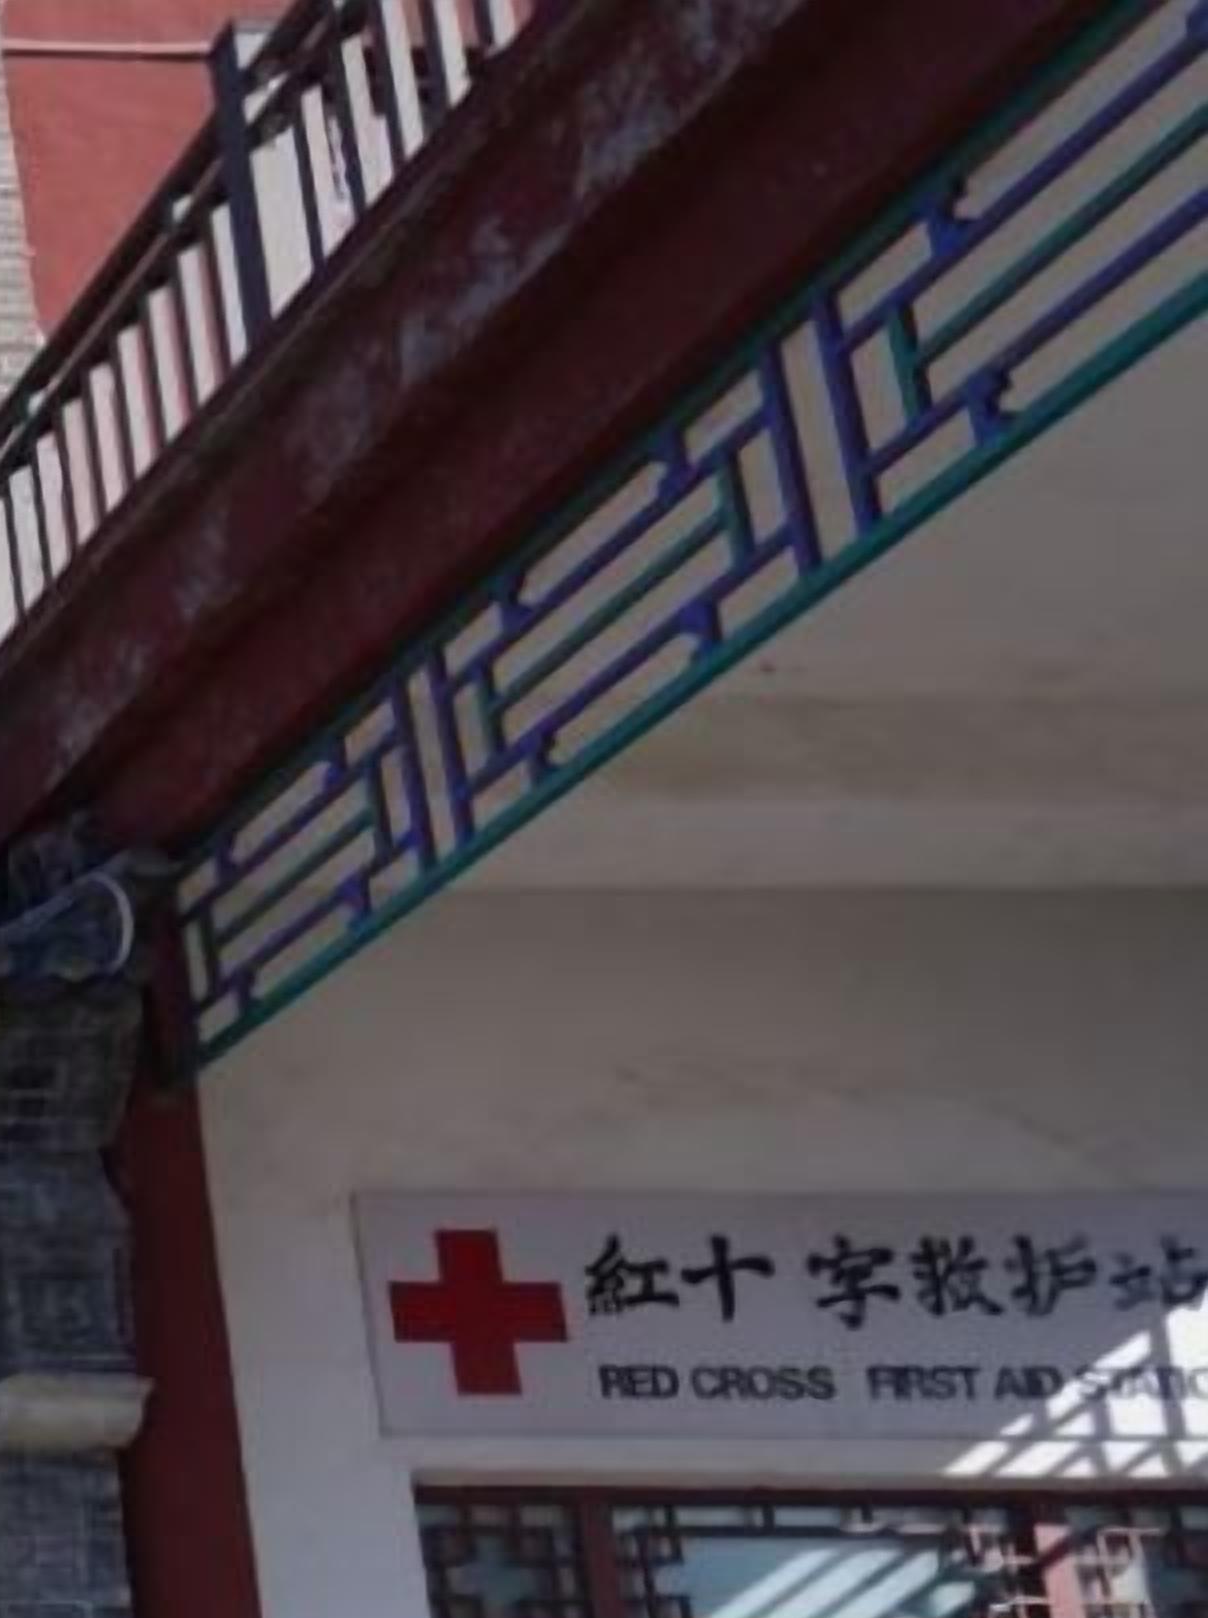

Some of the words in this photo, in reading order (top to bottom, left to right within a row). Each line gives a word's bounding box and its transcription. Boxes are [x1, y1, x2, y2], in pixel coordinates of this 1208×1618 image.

[598, 1364, 680, 1399] RED
[690, 1364, 837, 1401] CROSS
[866, 1365, 982, 1402] FIRST
[994, 1365, 1064, 1401] AID
